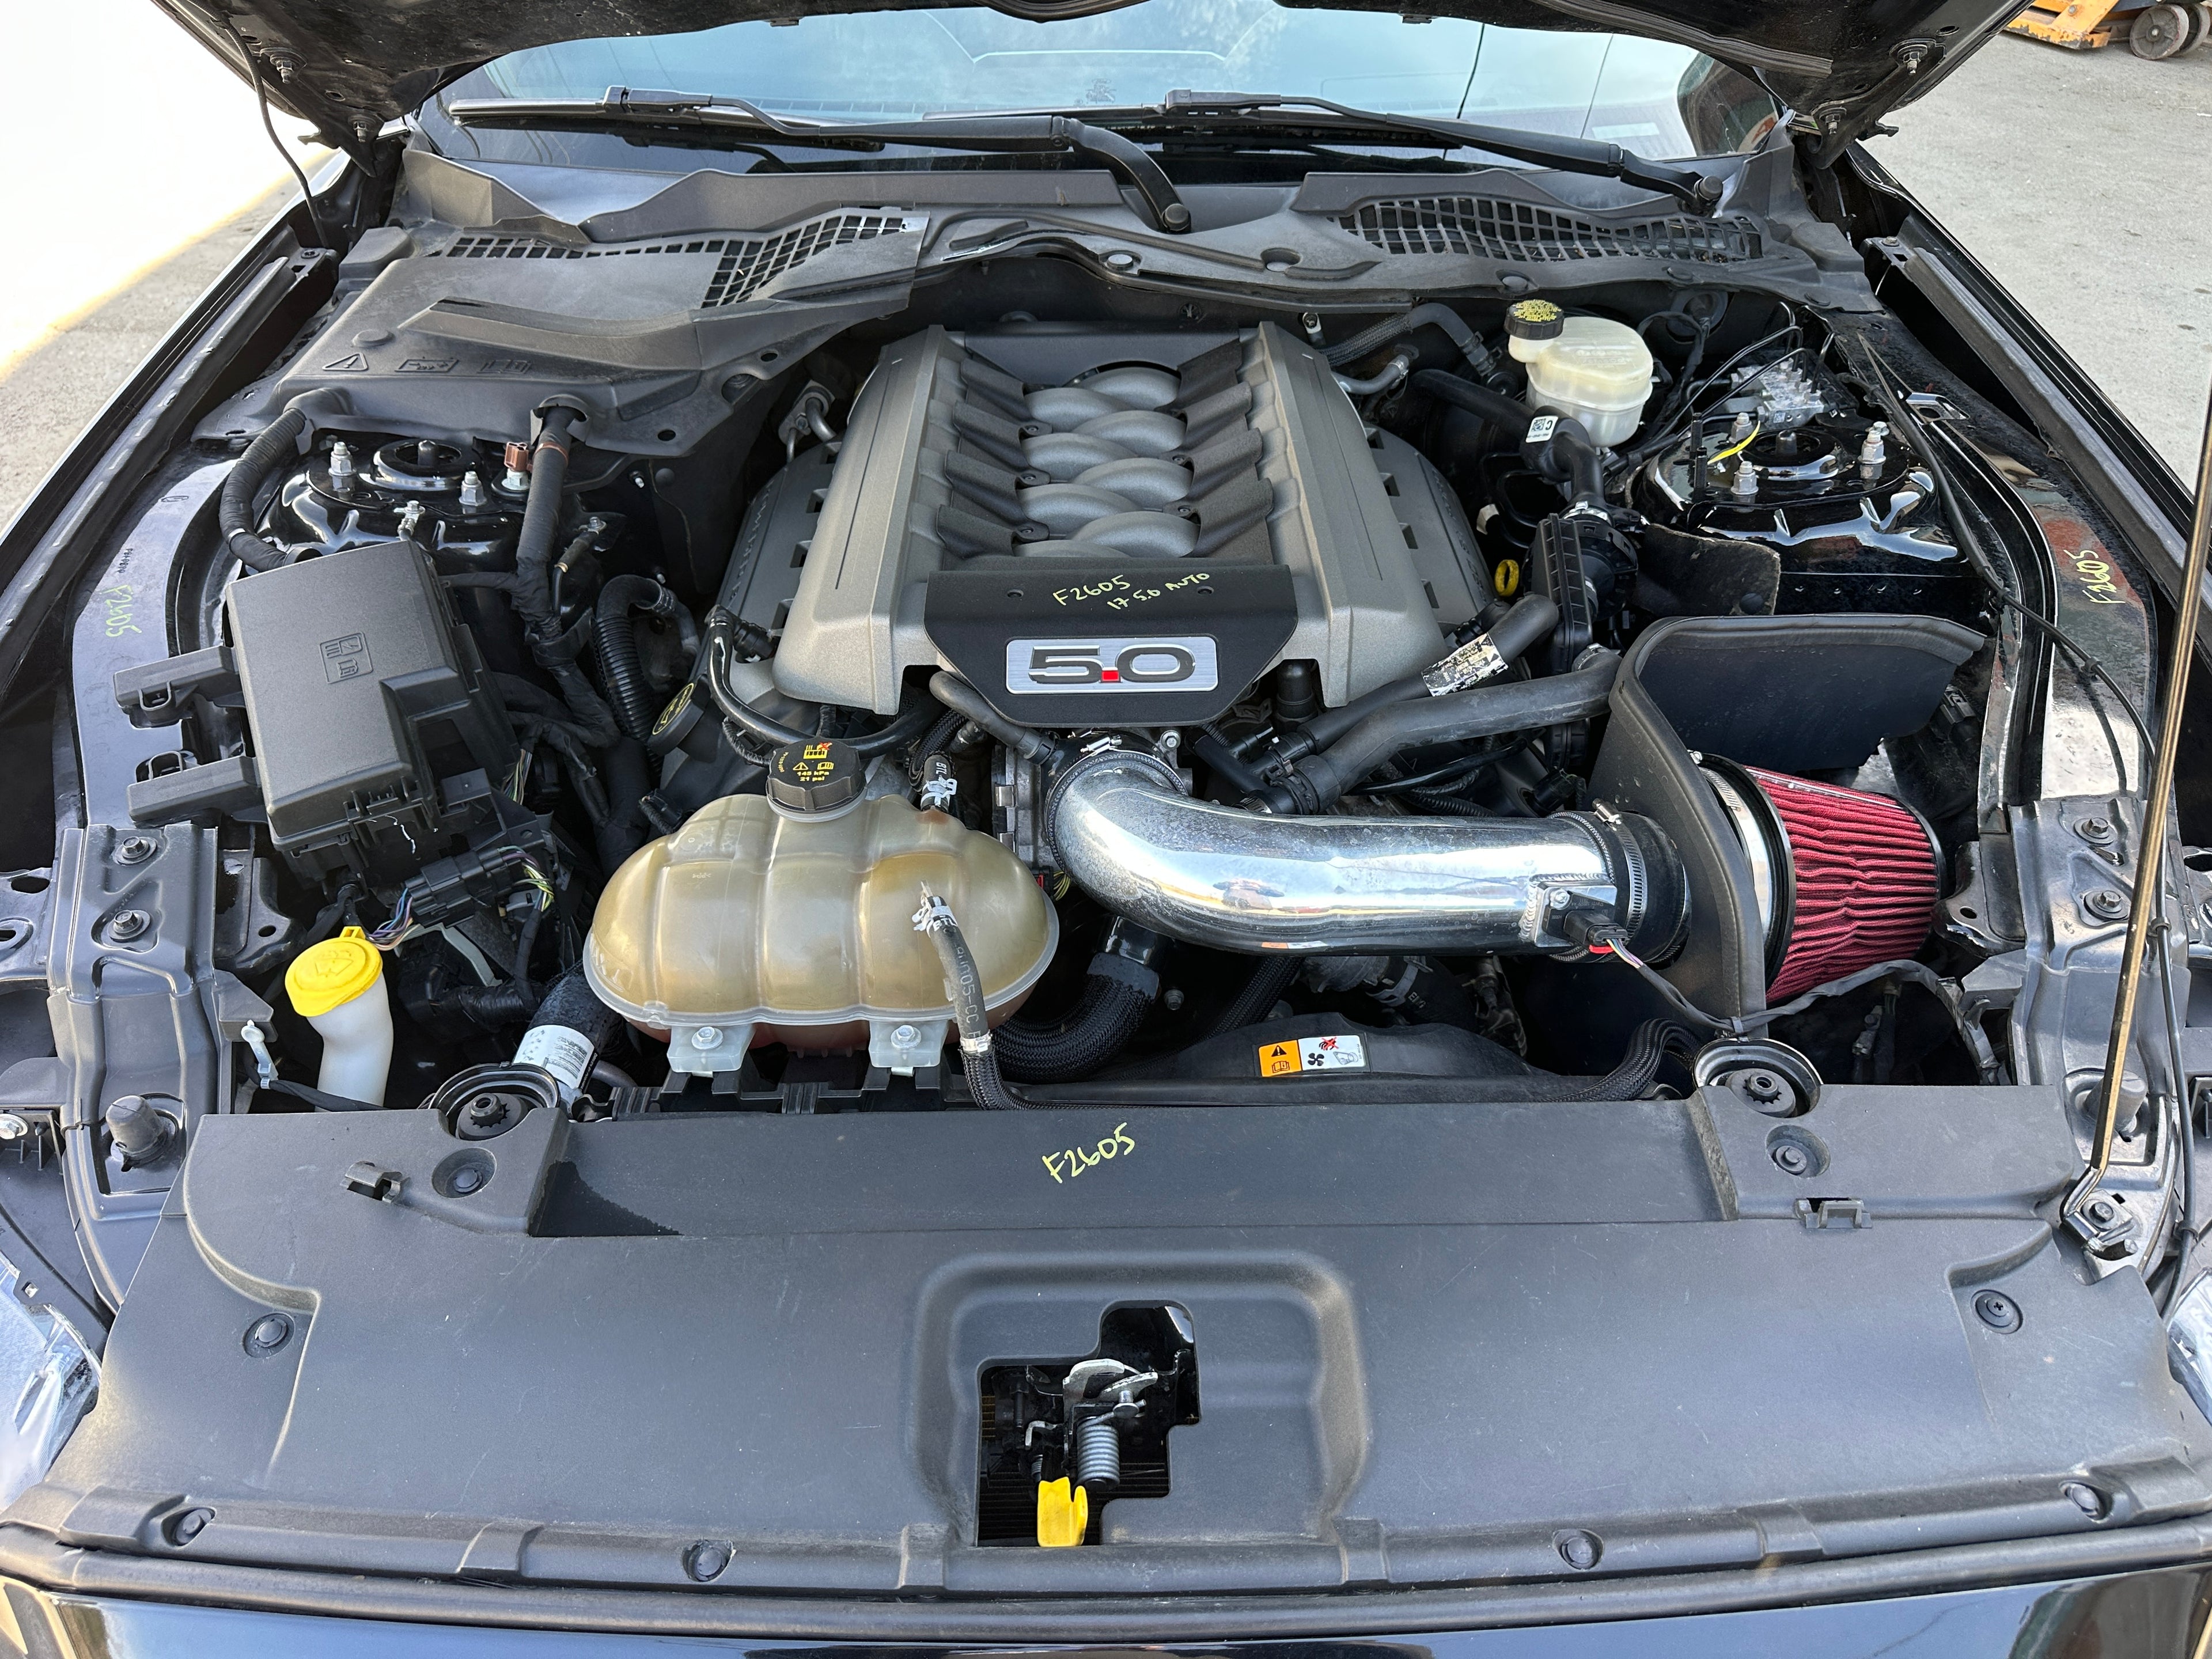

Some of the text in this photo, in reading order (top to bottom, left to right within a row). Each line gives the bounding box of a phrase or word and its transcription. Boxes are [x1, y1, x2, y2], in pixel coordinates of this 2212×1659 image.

[1052, 574, 1131, 606] F2605
[1107, 572, 1210, 610] 17 5.0 AUTO
[2063, 549, 2126, 603] F2605
[100, 584, 142, 638] F2605
[1028, 643, 1195, 684] 5.0
[935, 762, 948, 775] BTL
[1041, 1122, 1135, 1184] F2605
